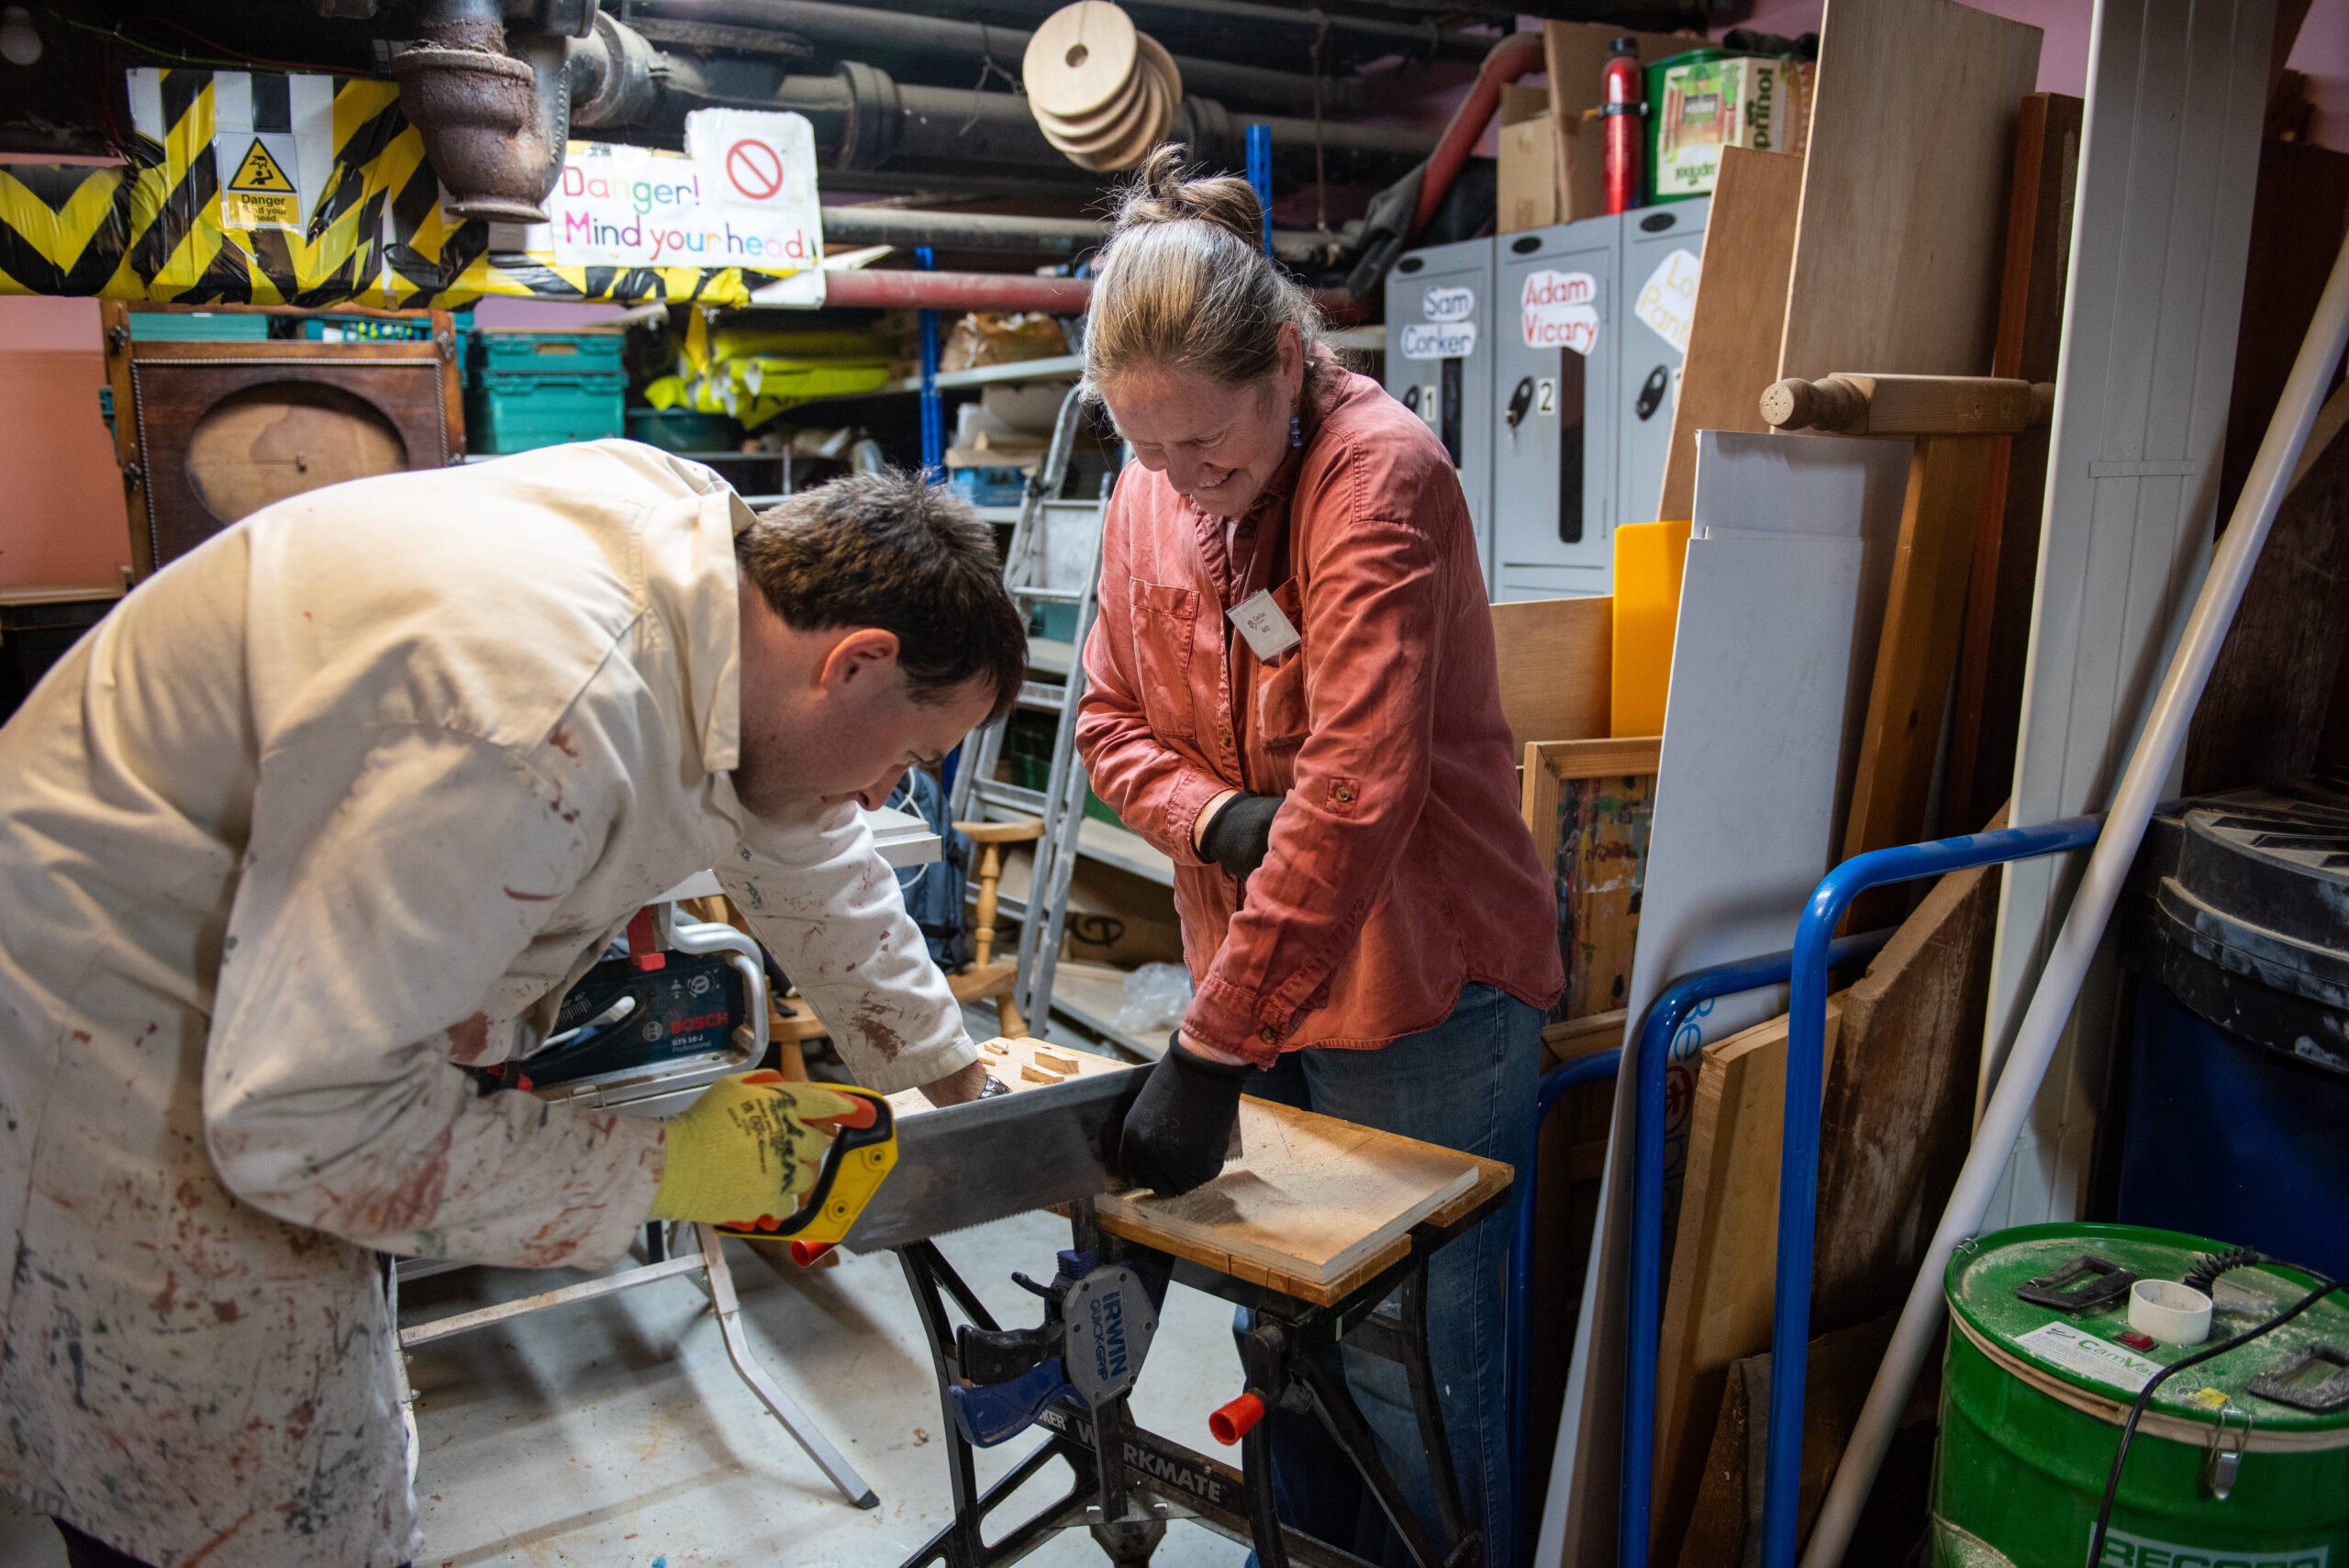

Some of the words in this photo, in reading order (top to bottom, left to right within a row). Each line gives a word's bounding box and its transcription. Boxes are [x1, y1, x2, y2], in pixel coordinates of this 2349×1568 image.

[241, 194, 285, 206] Danger
[562, 166, 700, 214] Danger!
[565, 210, 641, 247] Mind
[650, 228, 722, 261] your
[1426, 285, 1468, 316] Sam
[1524, 274, 1587, 307] Adam
[1404, 324, 1472, 354] Corker
[1524, 314, 1598, 353] Vicary
[1425, 391, 1433, 412] 1
[1540, 382, 1553, 412] 2
[670, 1011, 729, 1035] BOSCH
[672, 1037, 687, 1047] GTS
[688, 1035, 697, 1044] 10
[672, 1040, 712, 1053] Professional
[1102, 1291, 1128, 1377] IRWIN
[1038, 1408, 1067, 1431] KER
[1075, 1418, 1221, 1503] WRKMATE
